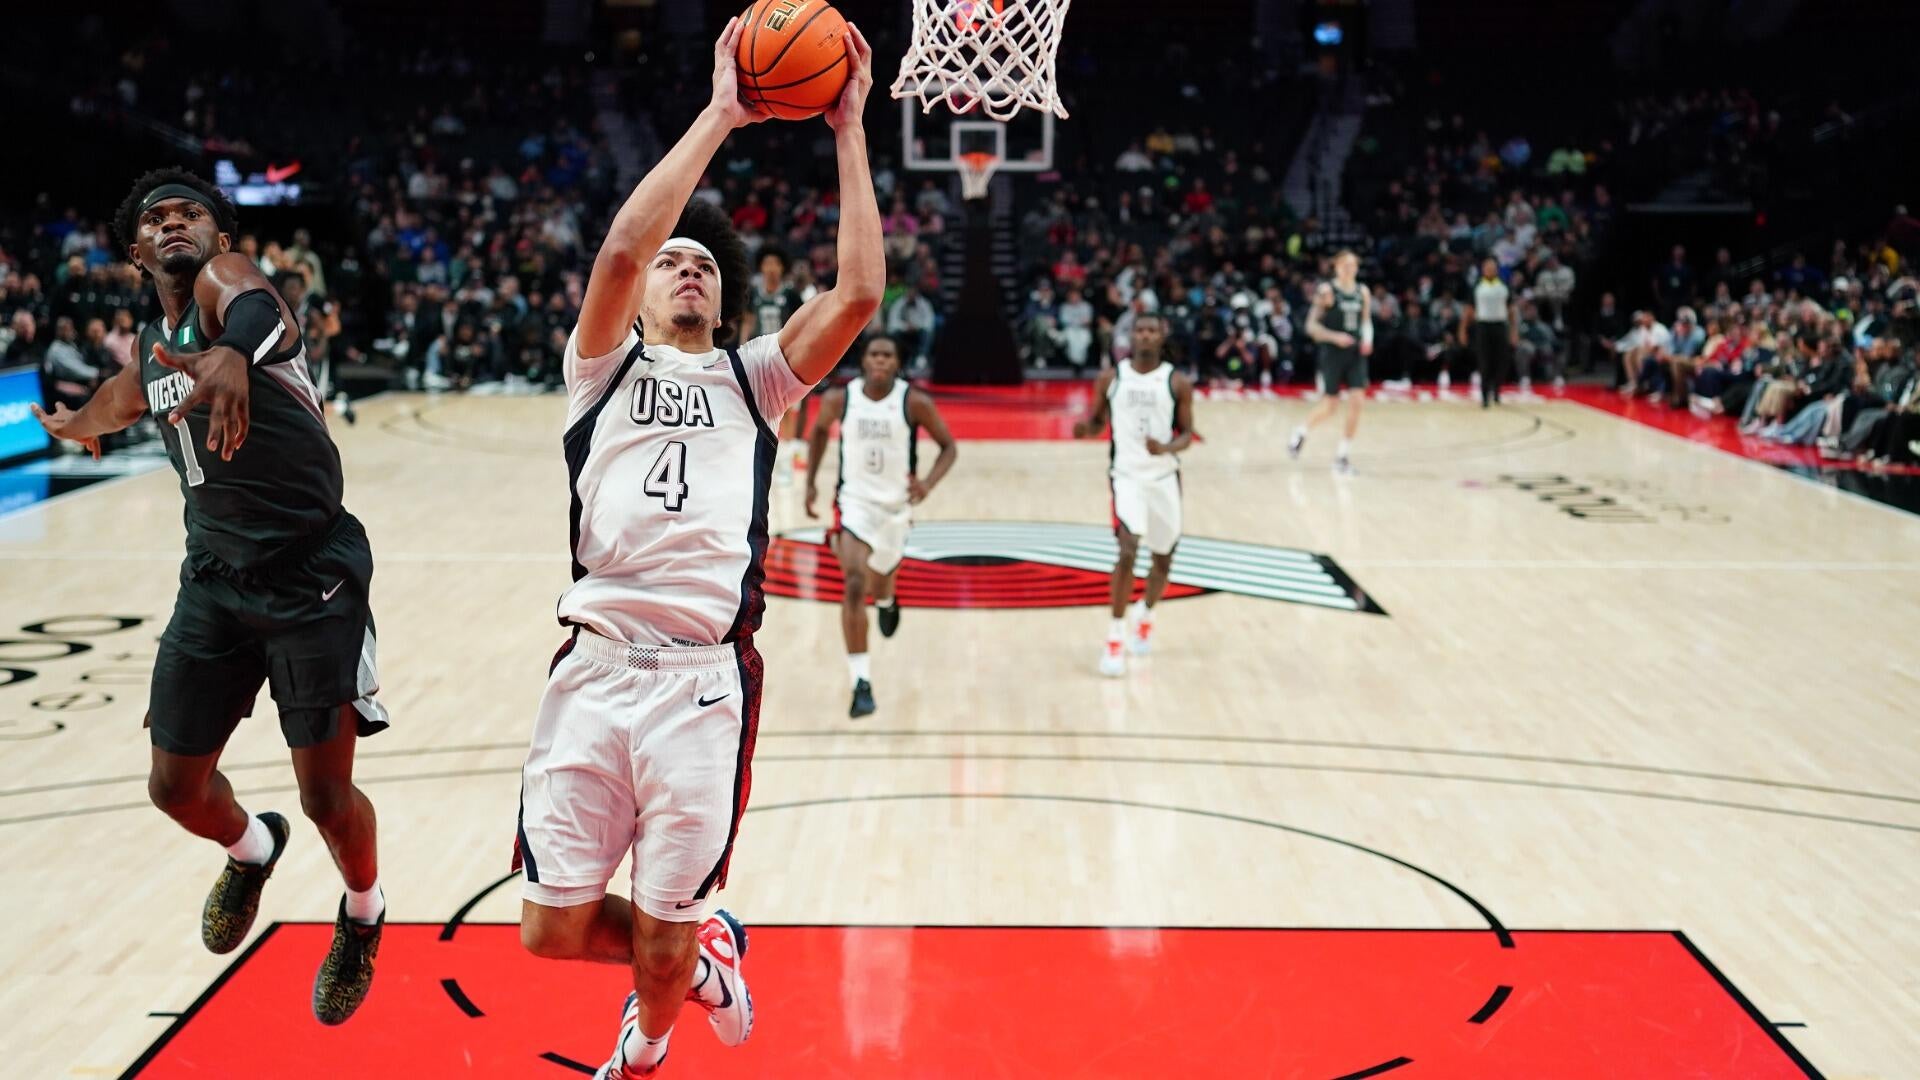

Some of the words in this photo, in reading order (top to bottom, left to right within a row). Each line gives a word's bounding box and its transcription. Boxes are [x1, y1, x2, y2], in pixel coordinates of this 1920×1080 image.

[630, 378, 715, 427] USA
[174, 416, 205, 487] 1
[857, 418, 892, 440] USA
[644, 441, 688, 512] 4
[671, 637, 690, 647] SPARKS
